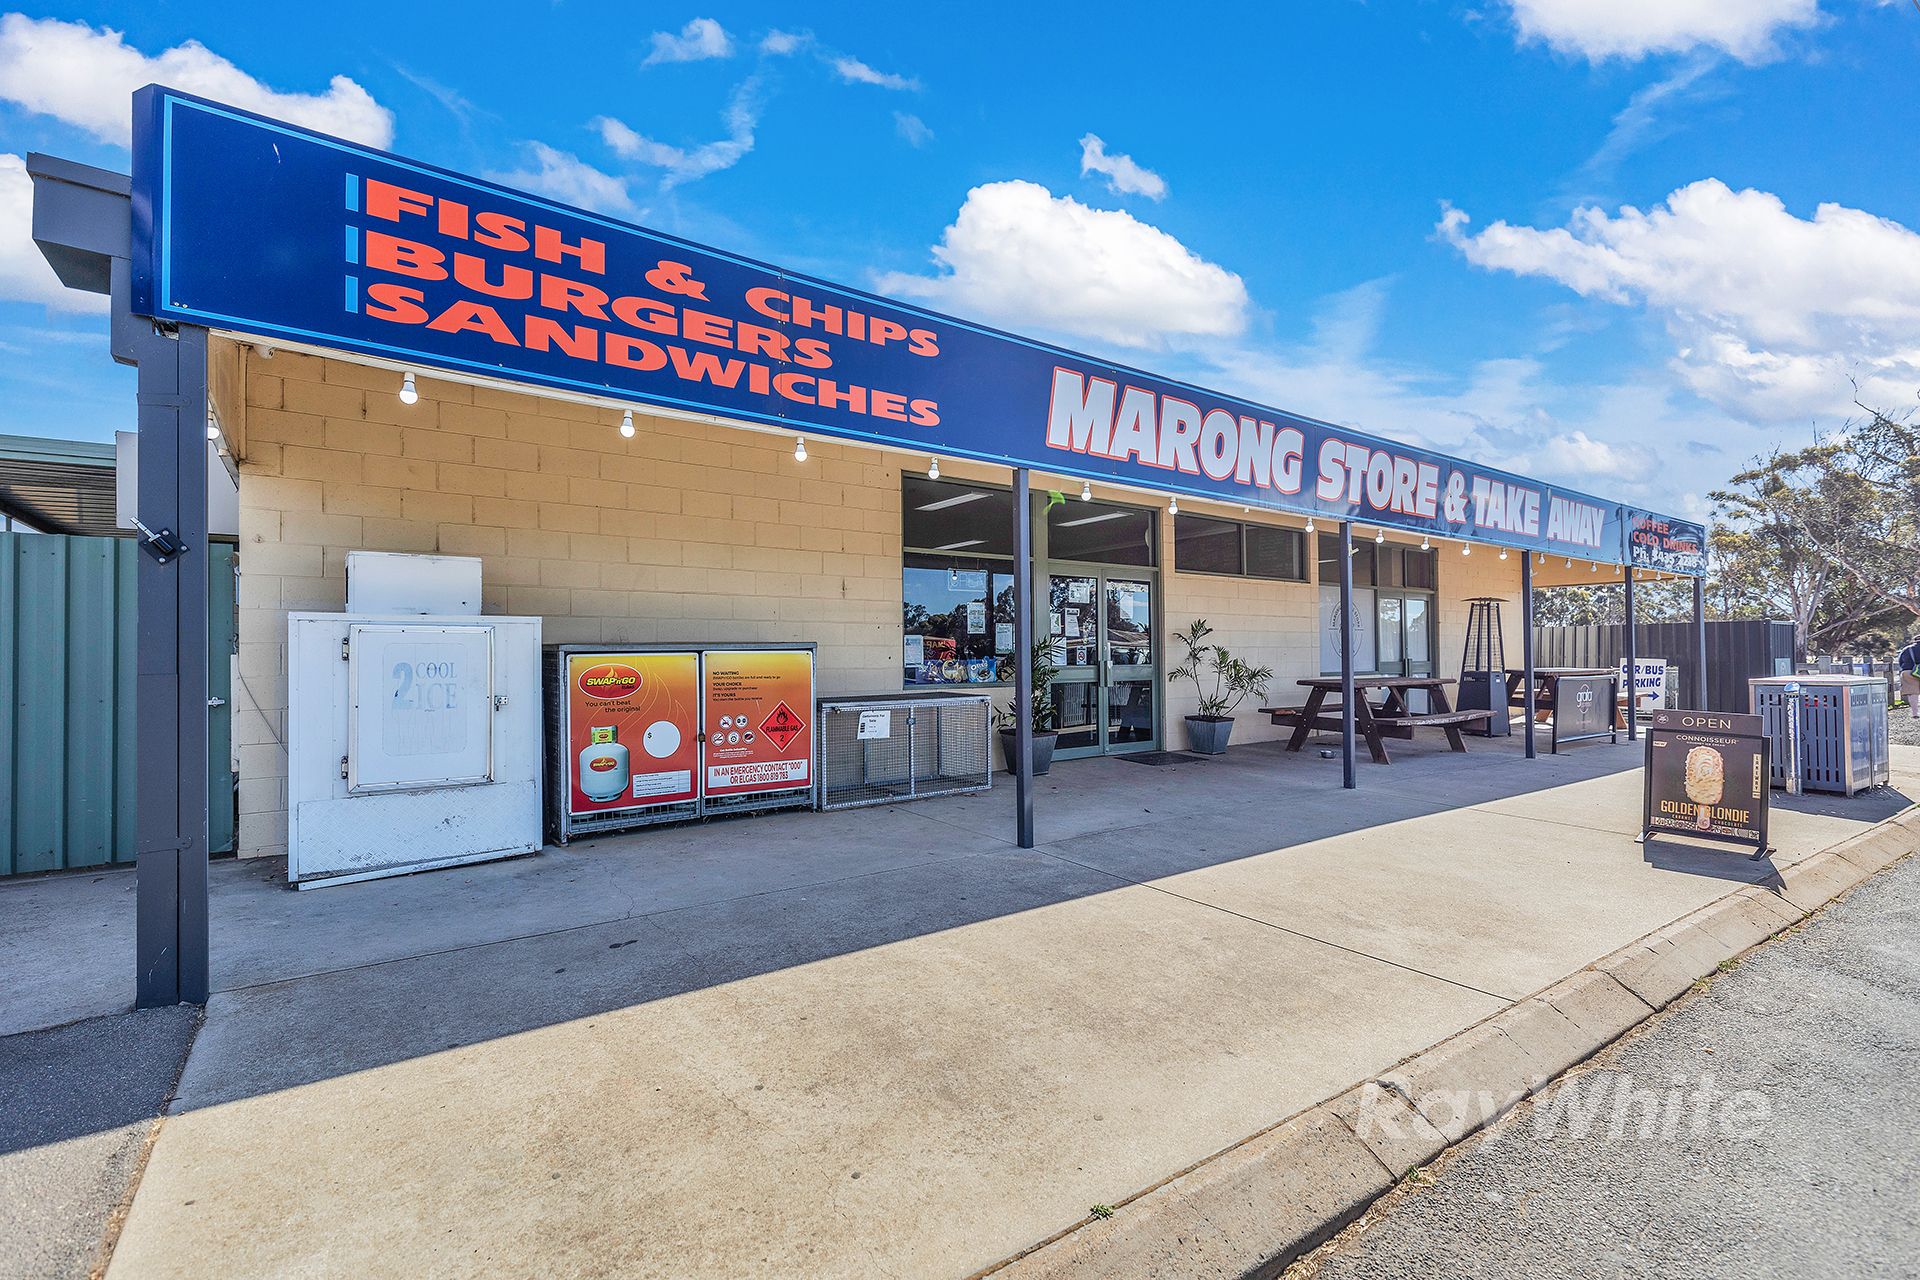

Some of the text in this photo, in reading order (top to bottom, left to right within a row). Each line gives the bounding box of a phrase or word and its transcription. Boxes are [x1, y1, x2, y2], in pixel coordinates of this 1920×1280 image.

[365, 178, 941, 358] FISH & CHIPS
[365, 230, 834, 370] BURGERS
[365, 282, 942, 427] SANDWICHES
[1046, 365, 1605, 547] MARONG STORE & TAKE AWAY
[1632, 516, 1668, 534] COFFEE
[1633, 531, 1697, 553] COLD DRINKS
[1622, 665, 1664, 675] CR/BUS
[392, 662, 457, 711] 2 COOL
[1622, 677, 1661, 688] PRKING
[416, 683, 457, 710] ICE
[1682, 716, 1731, 729] OPEN
[1676, 734, 1737, 745] CONNOISSEUR
[721, 767, 729, 775] AN
[730, 765, 763, 775] EMERGENCY
[764, 763, 788, 772] CONTACT
[730, 776, 738, 784] OR
[740, 774, 756, 783] ELGAS
[1661, 800, 1750, 824] GOLDEN BLONDIE
